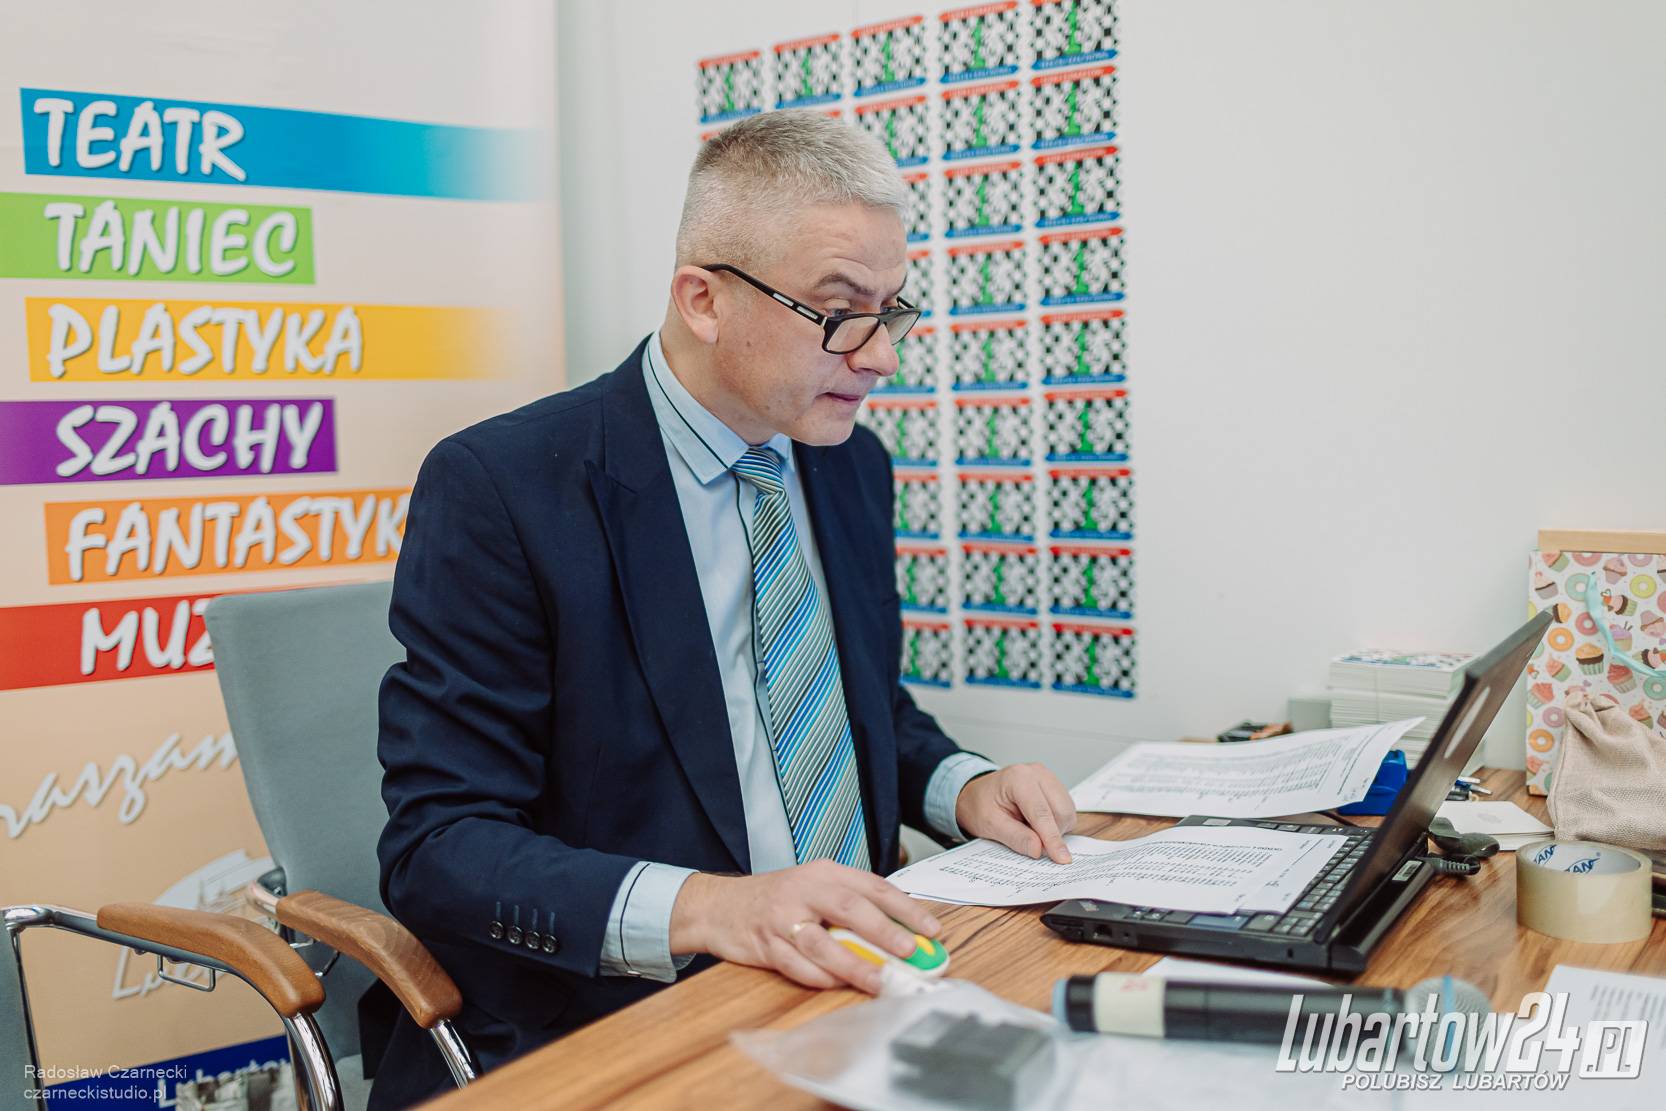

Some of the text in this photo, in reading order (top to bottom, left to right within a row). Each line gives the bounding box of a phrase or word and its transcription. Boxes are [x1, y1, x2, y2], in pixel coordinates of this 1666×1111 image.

[33, 97, 246, 182] TEATR
[44, 200, 298, 277] TANIEC
[47, 303, 364, 378] PLASTYKA
[56, 401, 324, 477] SZACHY
[65, 494, 409, 582] FANTASTYK
[80, 598, 215, 676] MUZ
[0, 732, 239, 839] raszam
